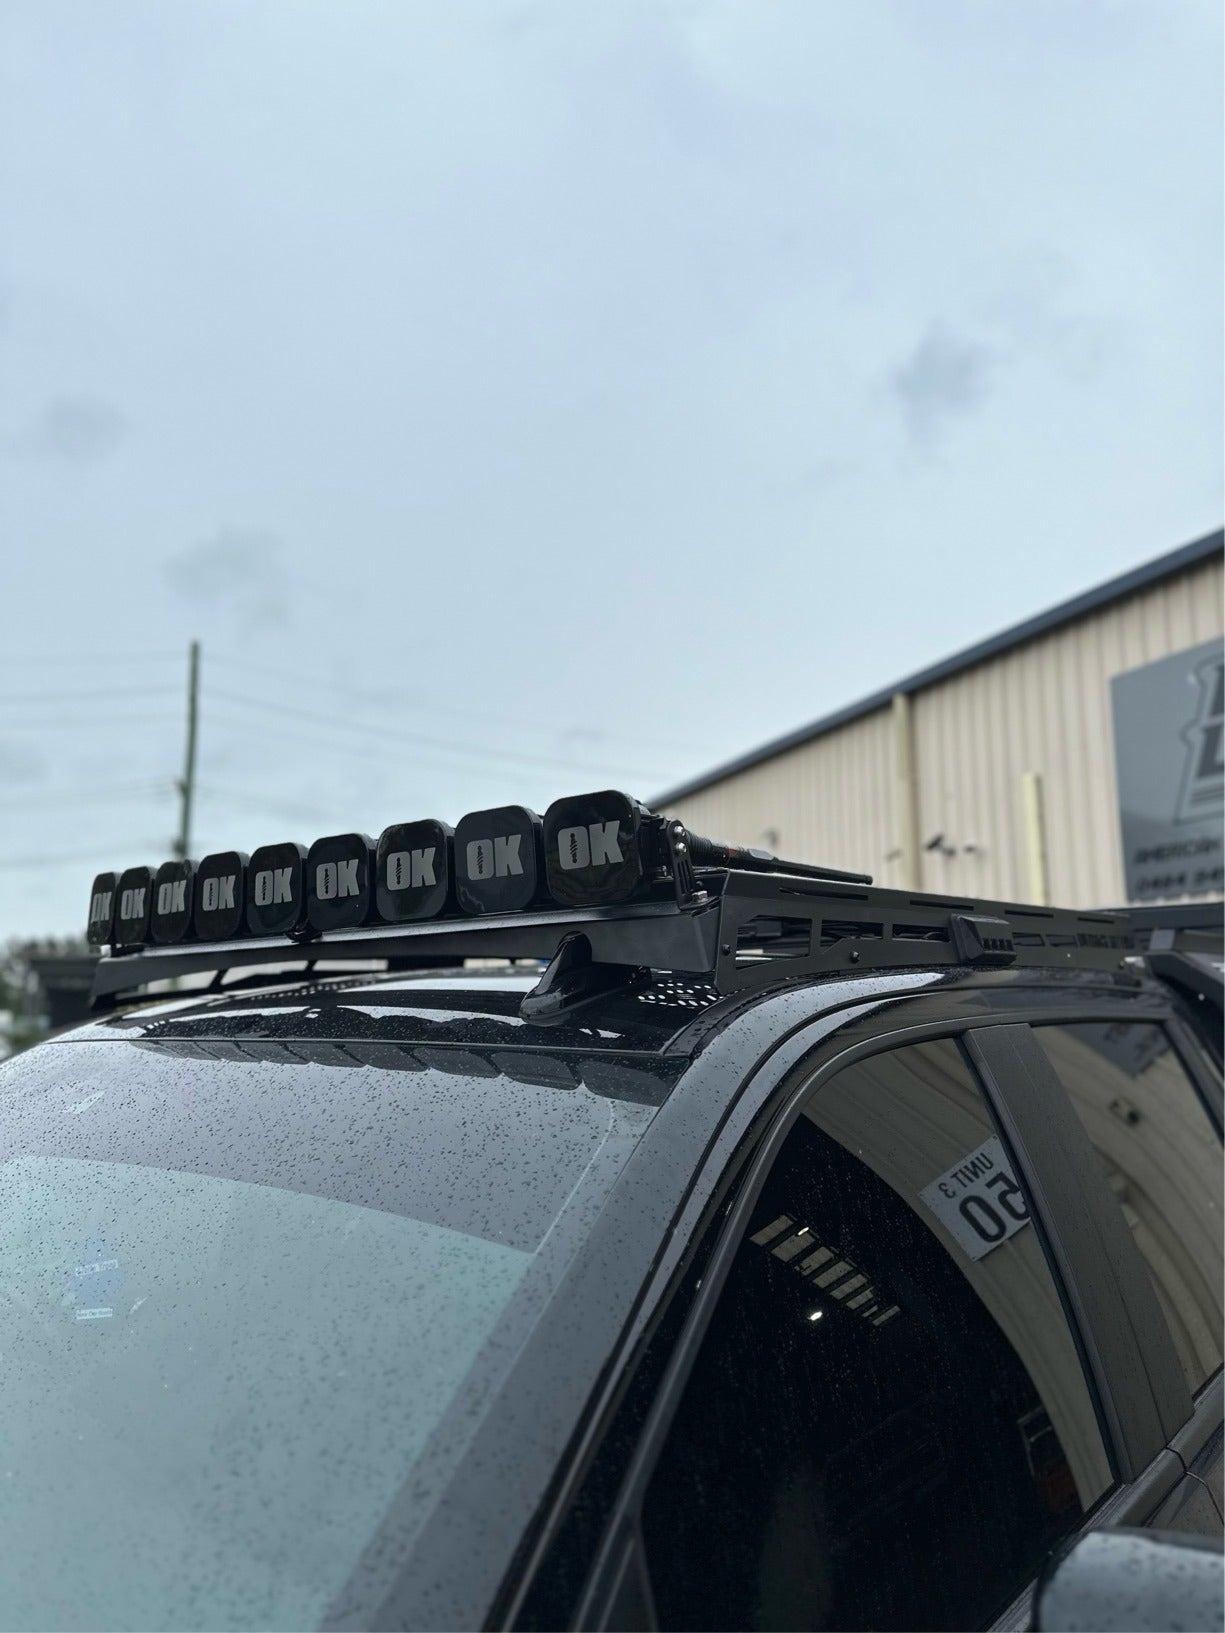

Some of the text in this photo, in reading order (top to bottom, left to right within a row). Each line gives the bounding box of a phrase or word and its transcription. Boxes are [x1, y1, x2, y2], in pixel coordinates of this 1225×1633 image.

[466, 834, 524, 881] OK
[557, 820, 624, 870] OK
[254, 867, 293, 906] OK
[315, 858, 360, 900] OK
[386, 847, 437, 891] OK
[90, 891, 112, 922] OK
[120, 887, 146, 920] OK
[157, 880, 187, 915] OK
[202, 874, 236, 911] OK
